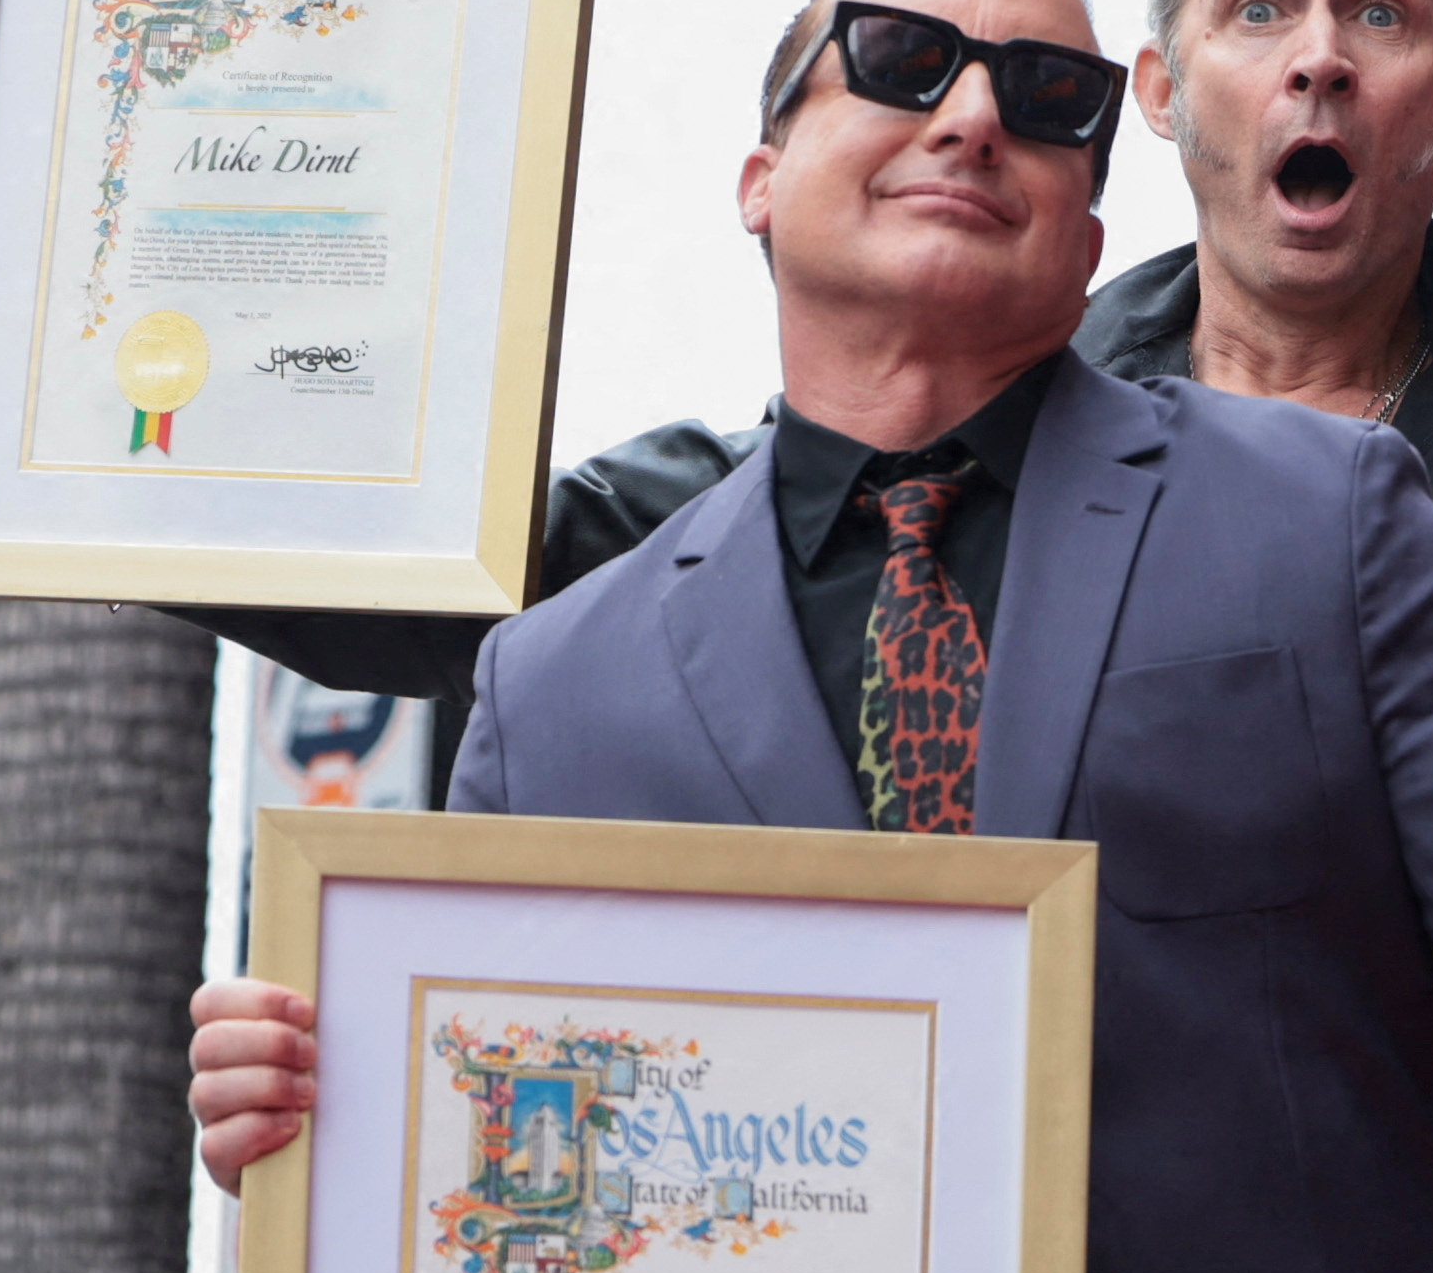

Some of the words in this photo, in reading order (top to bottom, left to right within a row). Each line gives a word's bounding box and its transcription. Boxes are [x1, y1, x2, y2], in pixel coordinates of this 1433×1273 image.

[222, 70, 266, 81] Certificate
[269, 70, 280, 81] of
[281, 72, 333, 83] Recognition
[174, 125, 266, 174] Mike
[272, 138, 362, 174] Dirnt
[599, 1056, 671, 1099] City
[677, 1058, 711, 1090] of
[659, 1089, 868, 1178] Angeles
[596, 1170, 684, 1214] State
[686, 1177, 711, 1206] of
[714, 1172, 868, 1219] California
